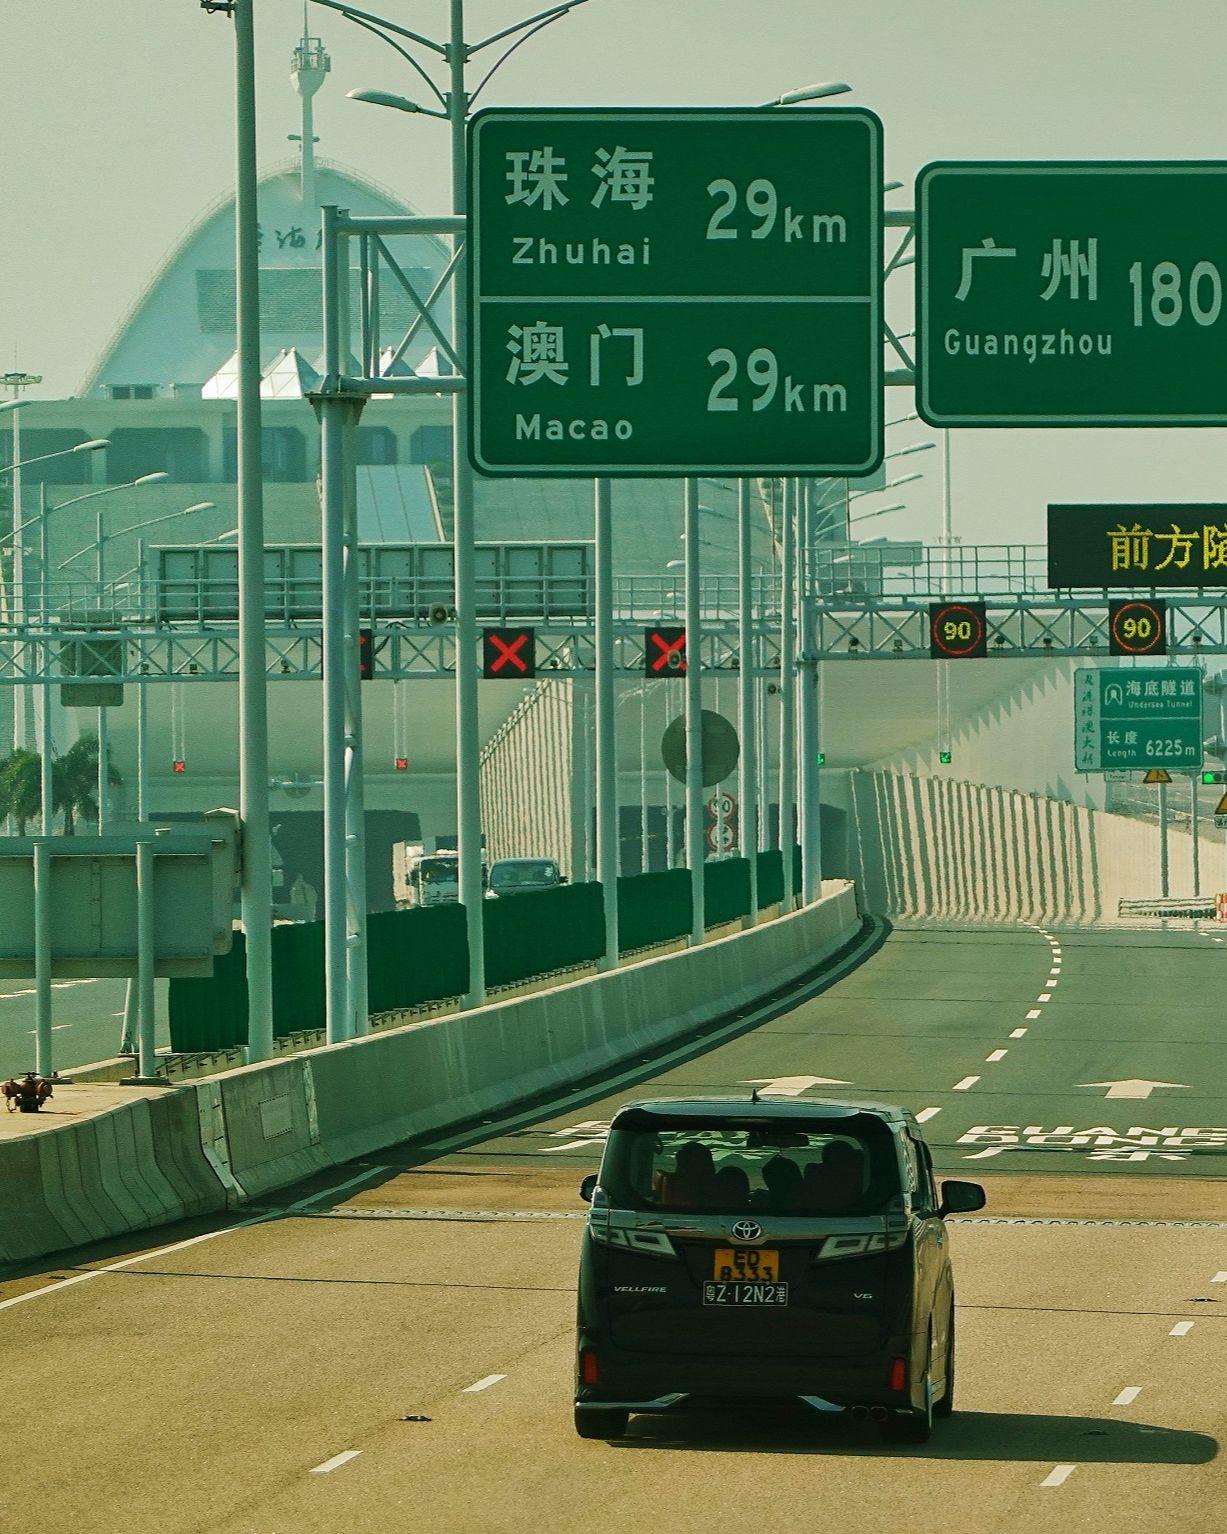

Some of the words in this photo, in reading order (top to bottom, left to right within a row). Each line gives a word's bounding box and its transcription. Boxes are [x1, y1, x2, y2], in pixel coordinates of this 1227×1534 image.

[504, 145, 655, 211] 珠海
[512, 237, 650, 265] Zhuhai
[954, 237, 1098, 302] 广州
[505, 320, 644, 387] 澳门
[944, 327, 1113, 364] Guangzhou
[515, 413, 634, 441] Macao
[944, 621, 971, 640] 90
[1123, 617, 1151, 638] 90
[1125, 679, 1196, 697] 海底隧道
[1128, 700, 1164, 709] Undersea
[1167, 700, 1193, 709] Tunnel
[1106, 730, 1138, 746] 长度
[1107, 749, 1137, 759] Length
[613, 1285, 668, 1294] VELLFIRE
